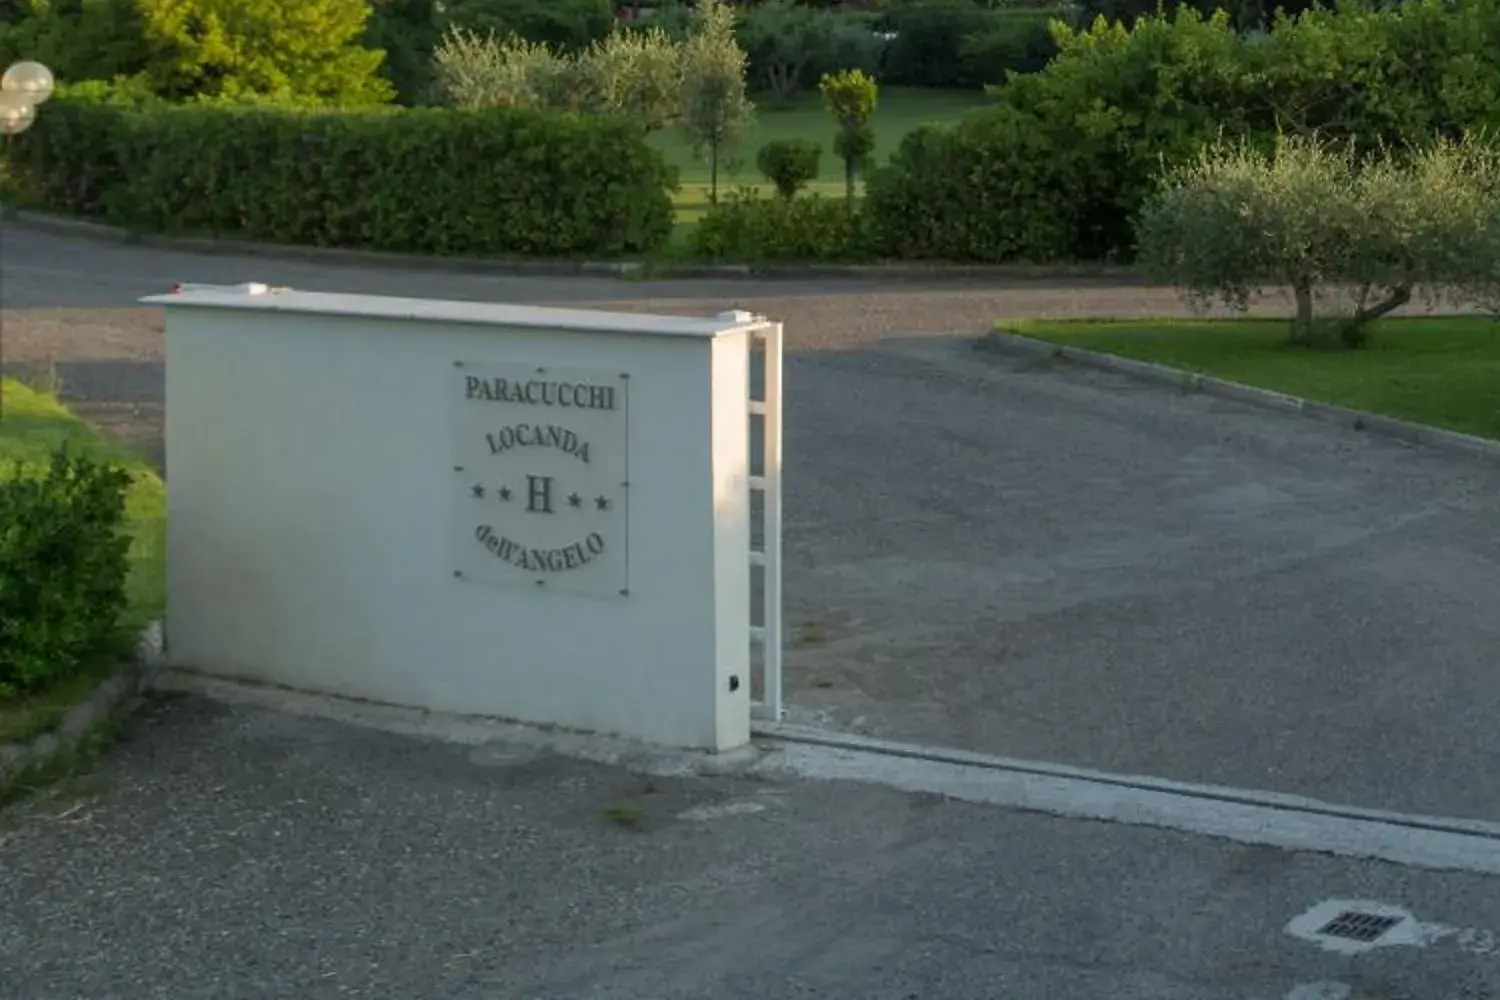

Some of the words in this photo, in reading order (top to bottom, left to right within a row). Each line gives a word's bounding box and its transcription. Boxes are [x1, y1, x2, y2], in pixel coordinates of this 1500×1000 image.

[465, 375, 616, 411] PARACUCCHI
[486, 423, 590, 464] LOCANDA
[525, 474, 555, 514] H
